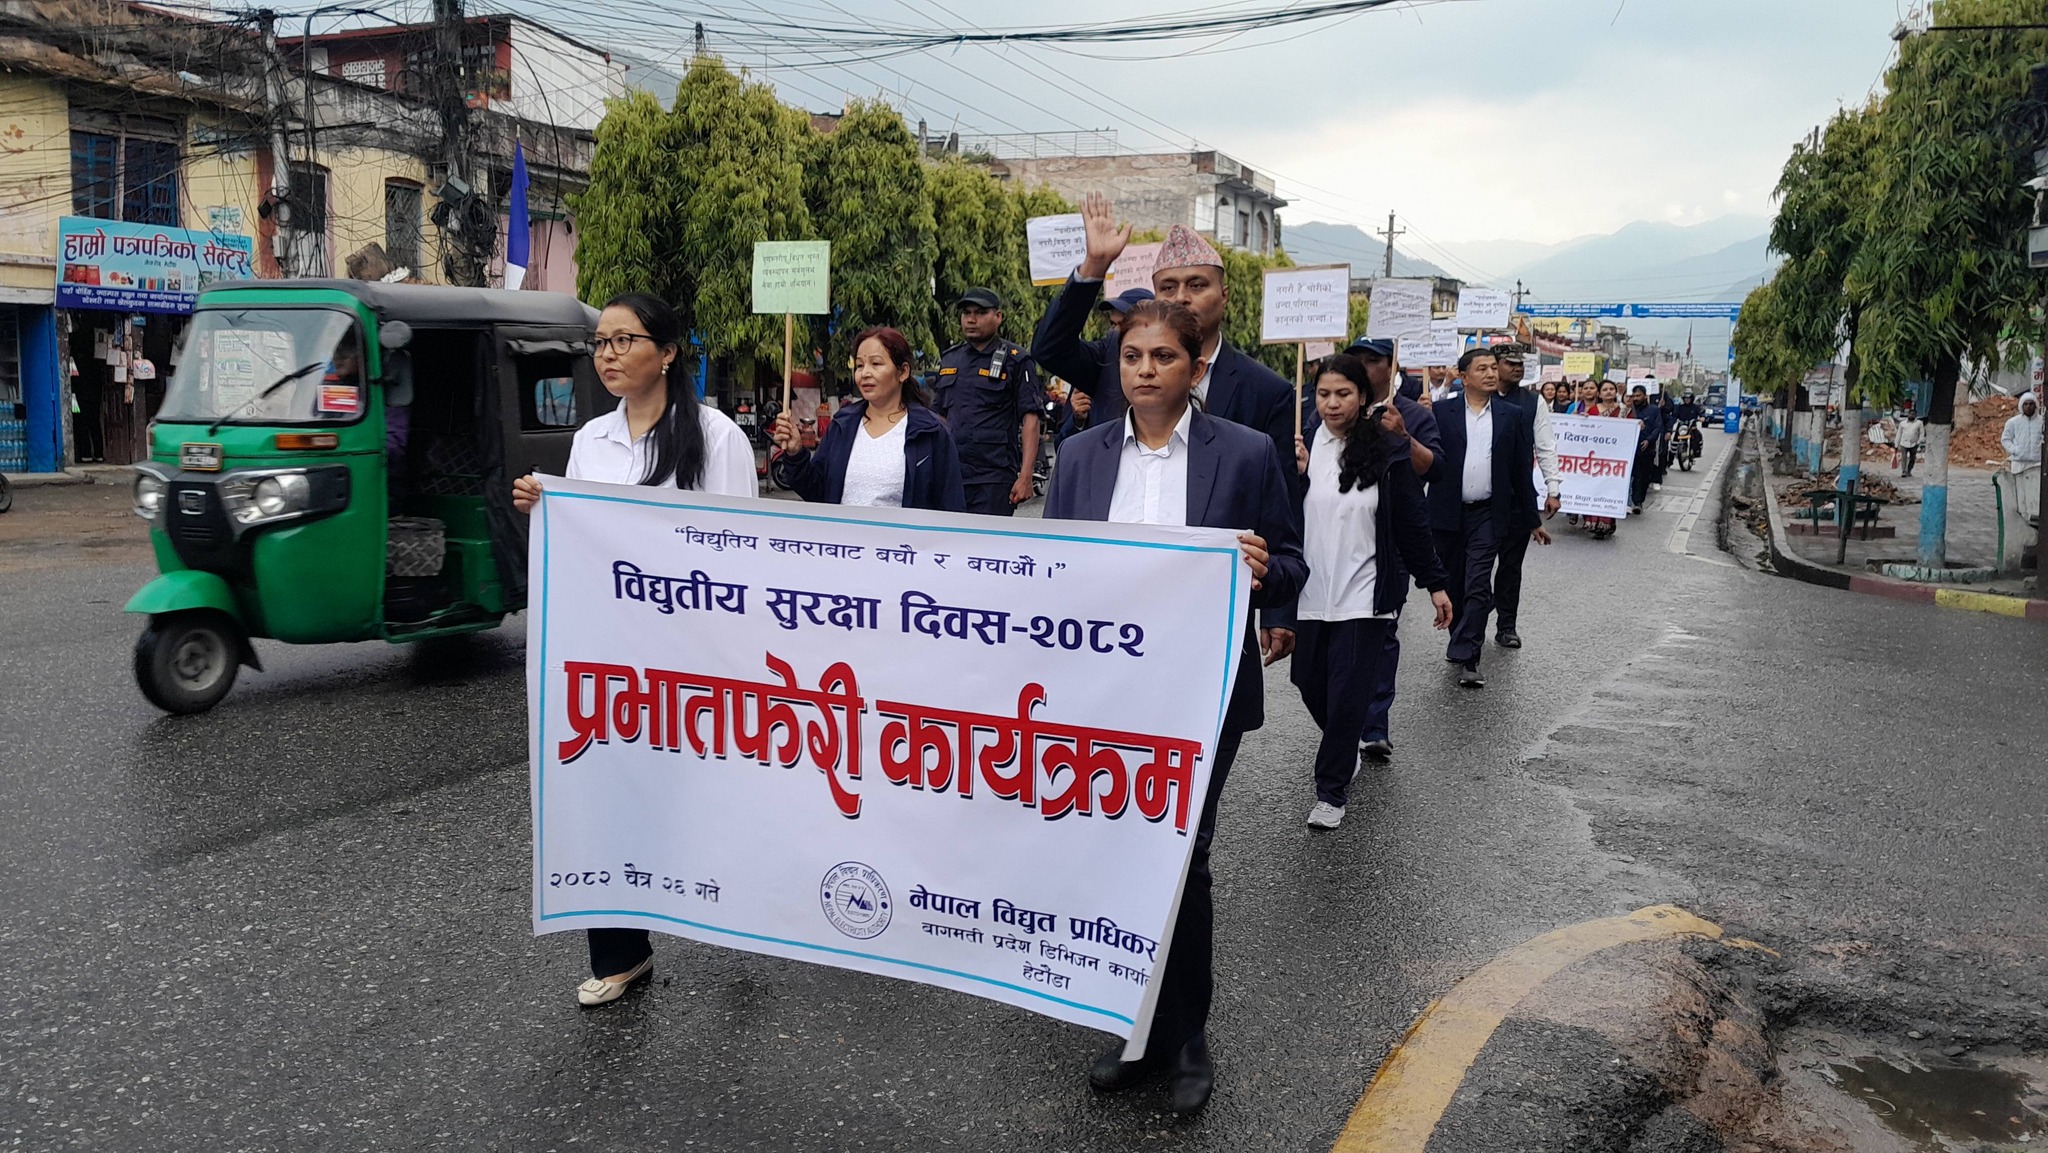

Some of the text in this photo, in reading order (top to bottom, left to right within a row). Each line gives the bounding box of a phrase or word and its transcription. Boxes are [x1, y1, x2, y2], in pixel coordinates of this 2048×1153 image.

[64, 229, 247, 275] हाम्रो पत्रपत्रिका सेन्टर
[1557, 450, 1628, 478] कार्यक्रम
[769, 537, 865, 560] खतराबाट
[933, 552, 951, 570] र
[612, 560, 1145, 657] विद्युतीय सुरक्षा दिवस-२०८२
[558, 650, 1203, 837] प्रभातफेरी कार्यक्रम
[550, 863, 721, 903] २०८२ चैत्र २६ गते
[909, 884, 982, 919] नेपाल
[992, 898, 1057, 934] विद्युत
[992, 933, 1032, 953] प्रदेश
[1040, 939, 1101, 971] डिभिजन
